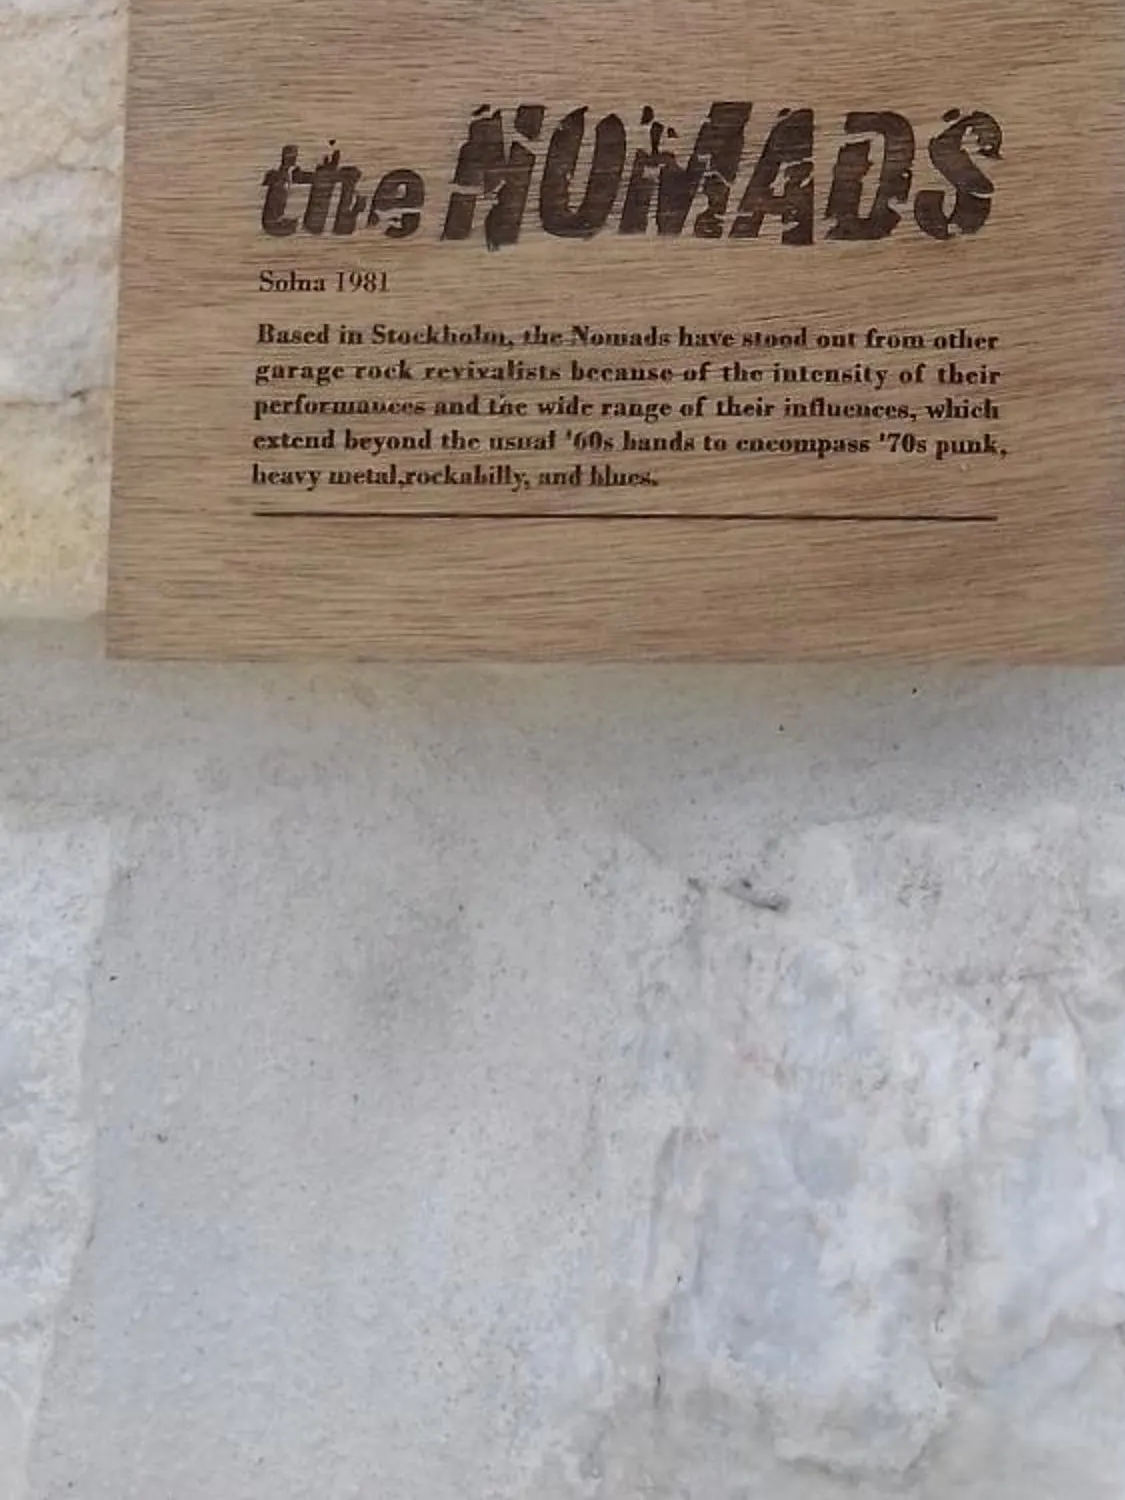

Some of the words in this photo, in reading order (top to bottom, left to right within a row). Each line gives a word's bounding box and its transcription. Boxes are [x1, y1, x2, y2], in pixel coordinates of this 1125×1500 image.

[261, 140, 425, 239] the
[440, 99, 1004, 252] NOMADS
[258, 270, 326, 293] Solna
[335, 270, 389, 293] 1981
[257, 323, 330, 345] Based
[339, 324, 364, 345] in
[371, 324, 515, 351] Stockholm,
[523, 325, 562, 348] the
[570, 326, 670, 349] Nomads
[678, 327, 736, 348] have
[741, 328, 808, 348] stood
[816, 331, 856, 349] out
[865, 328, 926, 349] from
[933, 329, 999, 351] other
[254, 362, 345, 387] garage
[355, 360, 413, 381] rock
[425, 361, 561, 382] revivalists
[571, 361, 673, 382] because
[683, 361, 711, 382] of
[722, 362, 764, 384] the
[772, 363, 889, 390] intensity
[899, 363, 926, 384] of
[937, 363, 1001, 386] their
[253, 394, 425, 420] performances
[434, 395, 480, 417] and
[489, 395, 527, 417] the
[537, 395, 594, 417] wide
[601, 403, 669, 424] range
[680, 396, 708, 417] of
[716, 396, 775, 417] their
[784, 397, 916, 422] influences,
[926, 398, 999, 420] which
[253, 430, 336, 450] extend
[345, 430, 431, 456] beyond
[441, 429, 480, 450] the
[489, 430, 556, 451] usual
[623, 431, 694, 453] bands
[703, 434, 728, 453] to
[736, 436, 870, 459] encompass
[880, 432, 927, 454] '70s
[935, 432, 1007, 460] punk,
[252, 464, 321, 491] heavy
[538, 465, 582, 487] and
[590, 465, 658, 488] blues.
